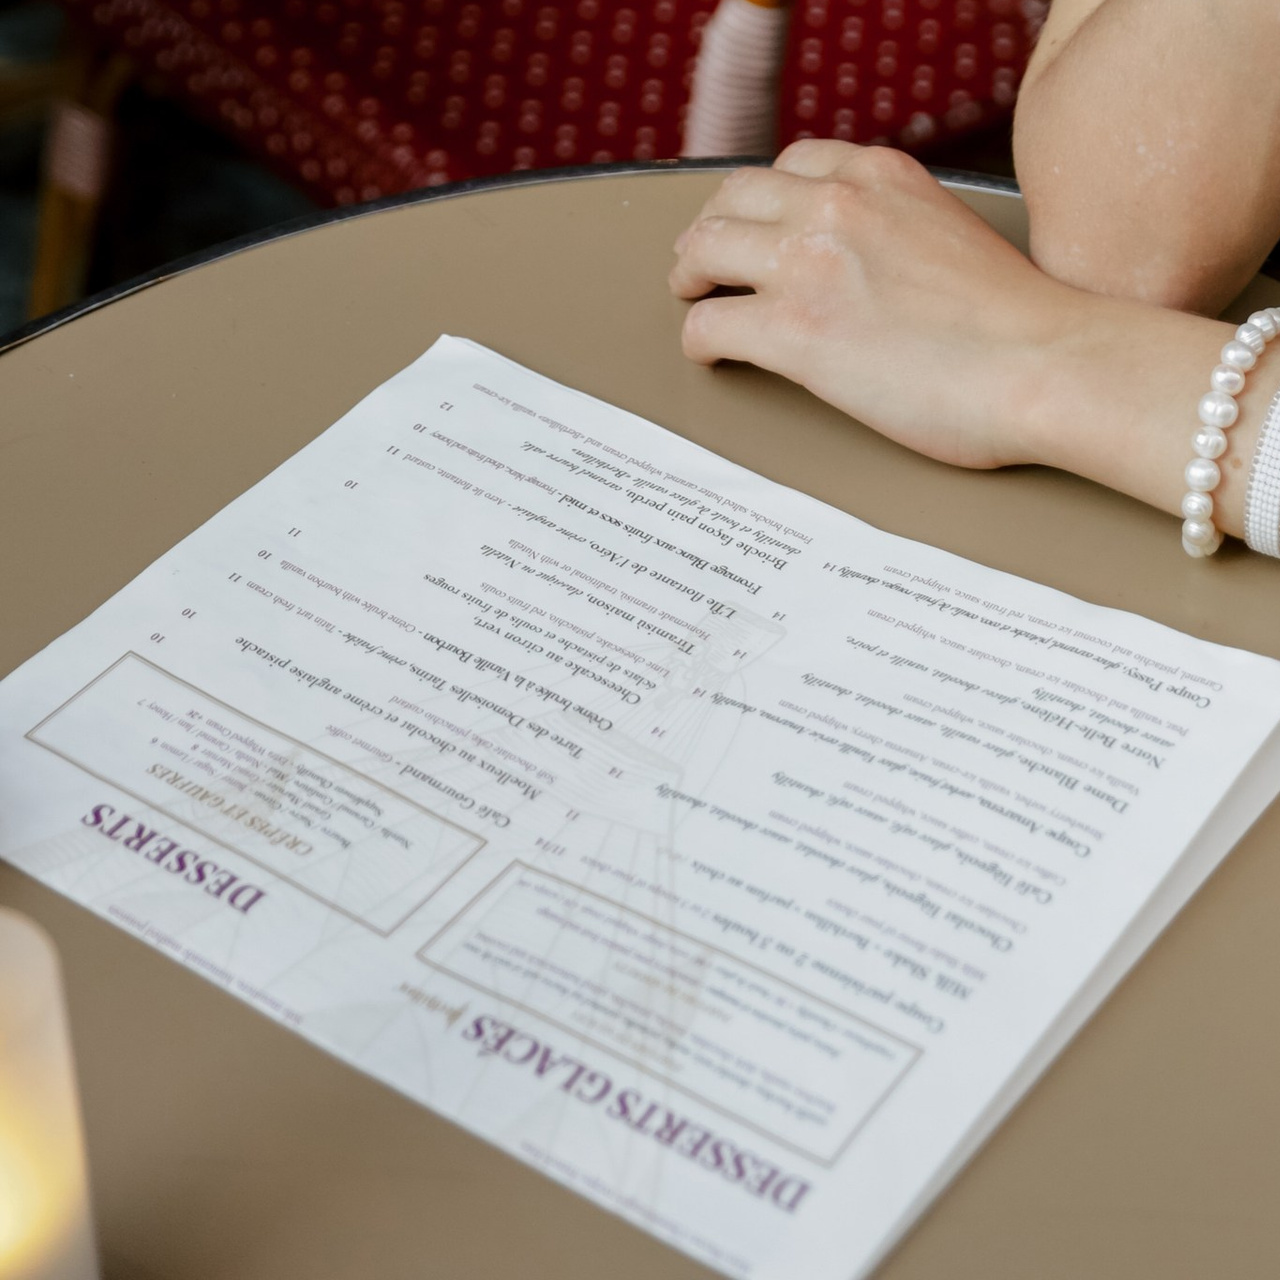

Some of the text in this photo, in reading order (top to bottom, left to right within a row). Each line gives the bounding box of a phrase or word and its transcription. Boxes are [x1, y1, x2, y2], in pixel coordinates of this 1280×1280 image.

[439, 401, 455, 412] 12
[386, 445, 401, 456] 11
[545, 453, 581, 473] beurre
[344, 479, 359, 490] 10
[574, 468, 623, 492] caramel
[632, 477, 669, 495] vanille
[412, 423, 763, 596] Fromage Blanc aux fruits secs et miel 10
[625, 488, 669, 512] perdu,
[668, 492, 701, 507] glace
[696, 504, 712, 516] de
[666, 508, 700, 525] pain
[710, 511, 741, 530] boule
[697, 522, 735, 547] façon
[738, 525, 753, 533] et
[507, 538, 541, 560] Nutella
[751, 530, 802, 556] chantilly
[257, 549, 273, 560] 10
[480, 544, 522, 569] Nutella
[540, 554, 560, 568] with
[735, 541, 788, 571] Brioche
[228, 572, 243, 583] 11
[279, 559, 307, 578] vanilla
[520, 564, 537, 574] ou
[559, 564, 572, 572] or
[246, 580, 274, 598] cream
[306, 573, 343, 597] bourbon
[569, 568, 619, 595] traditional
[272, 594, 296, 612] fresh
[341, 590, 362, 605] with
[586, 593, 636, 622] maison,
[287, 527, 642, 705] Cheesecake au citron vert, 11
[313, 616, 337, 634] Tatin
[386, 614, 417, 633] Crème
[657, 610, 712, 642] Homemade
[771, 611, 787, 622] 14
[423, 573, 657, 691] éclats de pistache et coulis de fruits rouges
[636, 619, 696, 656] Tiramisù
[376, 649, 408, 667] crème
[422, 632, 474, 664] Bourbon
[732, 648, 748, 660] 14
[409, 663, 447, 692] Tatins,
[473, 656, 511, 682] Vanille
[513, 674, 527, 689] la
[525, 680, 537, 692] à
[181, 607, 543, 801] Moelleux au chocolat et crème anglaise pistache 10
[449, 684, 526, 729] Demoiselles
[572, 704, 614, 732] Crème
[149, 632, 512, 829] Café Gourmand Gourmet coffee 10
[526, 721, 550, 739] des
[549, 734, 584, 760] Tarte
[145, 763, 314, 857] CRÊPES ET GAUFRES
[80, 803, 266, 915] DESSERTS
[461, 1015, 613, 1105] GLACÉS
[606, 1090, 812, 1212] DESSERTS
